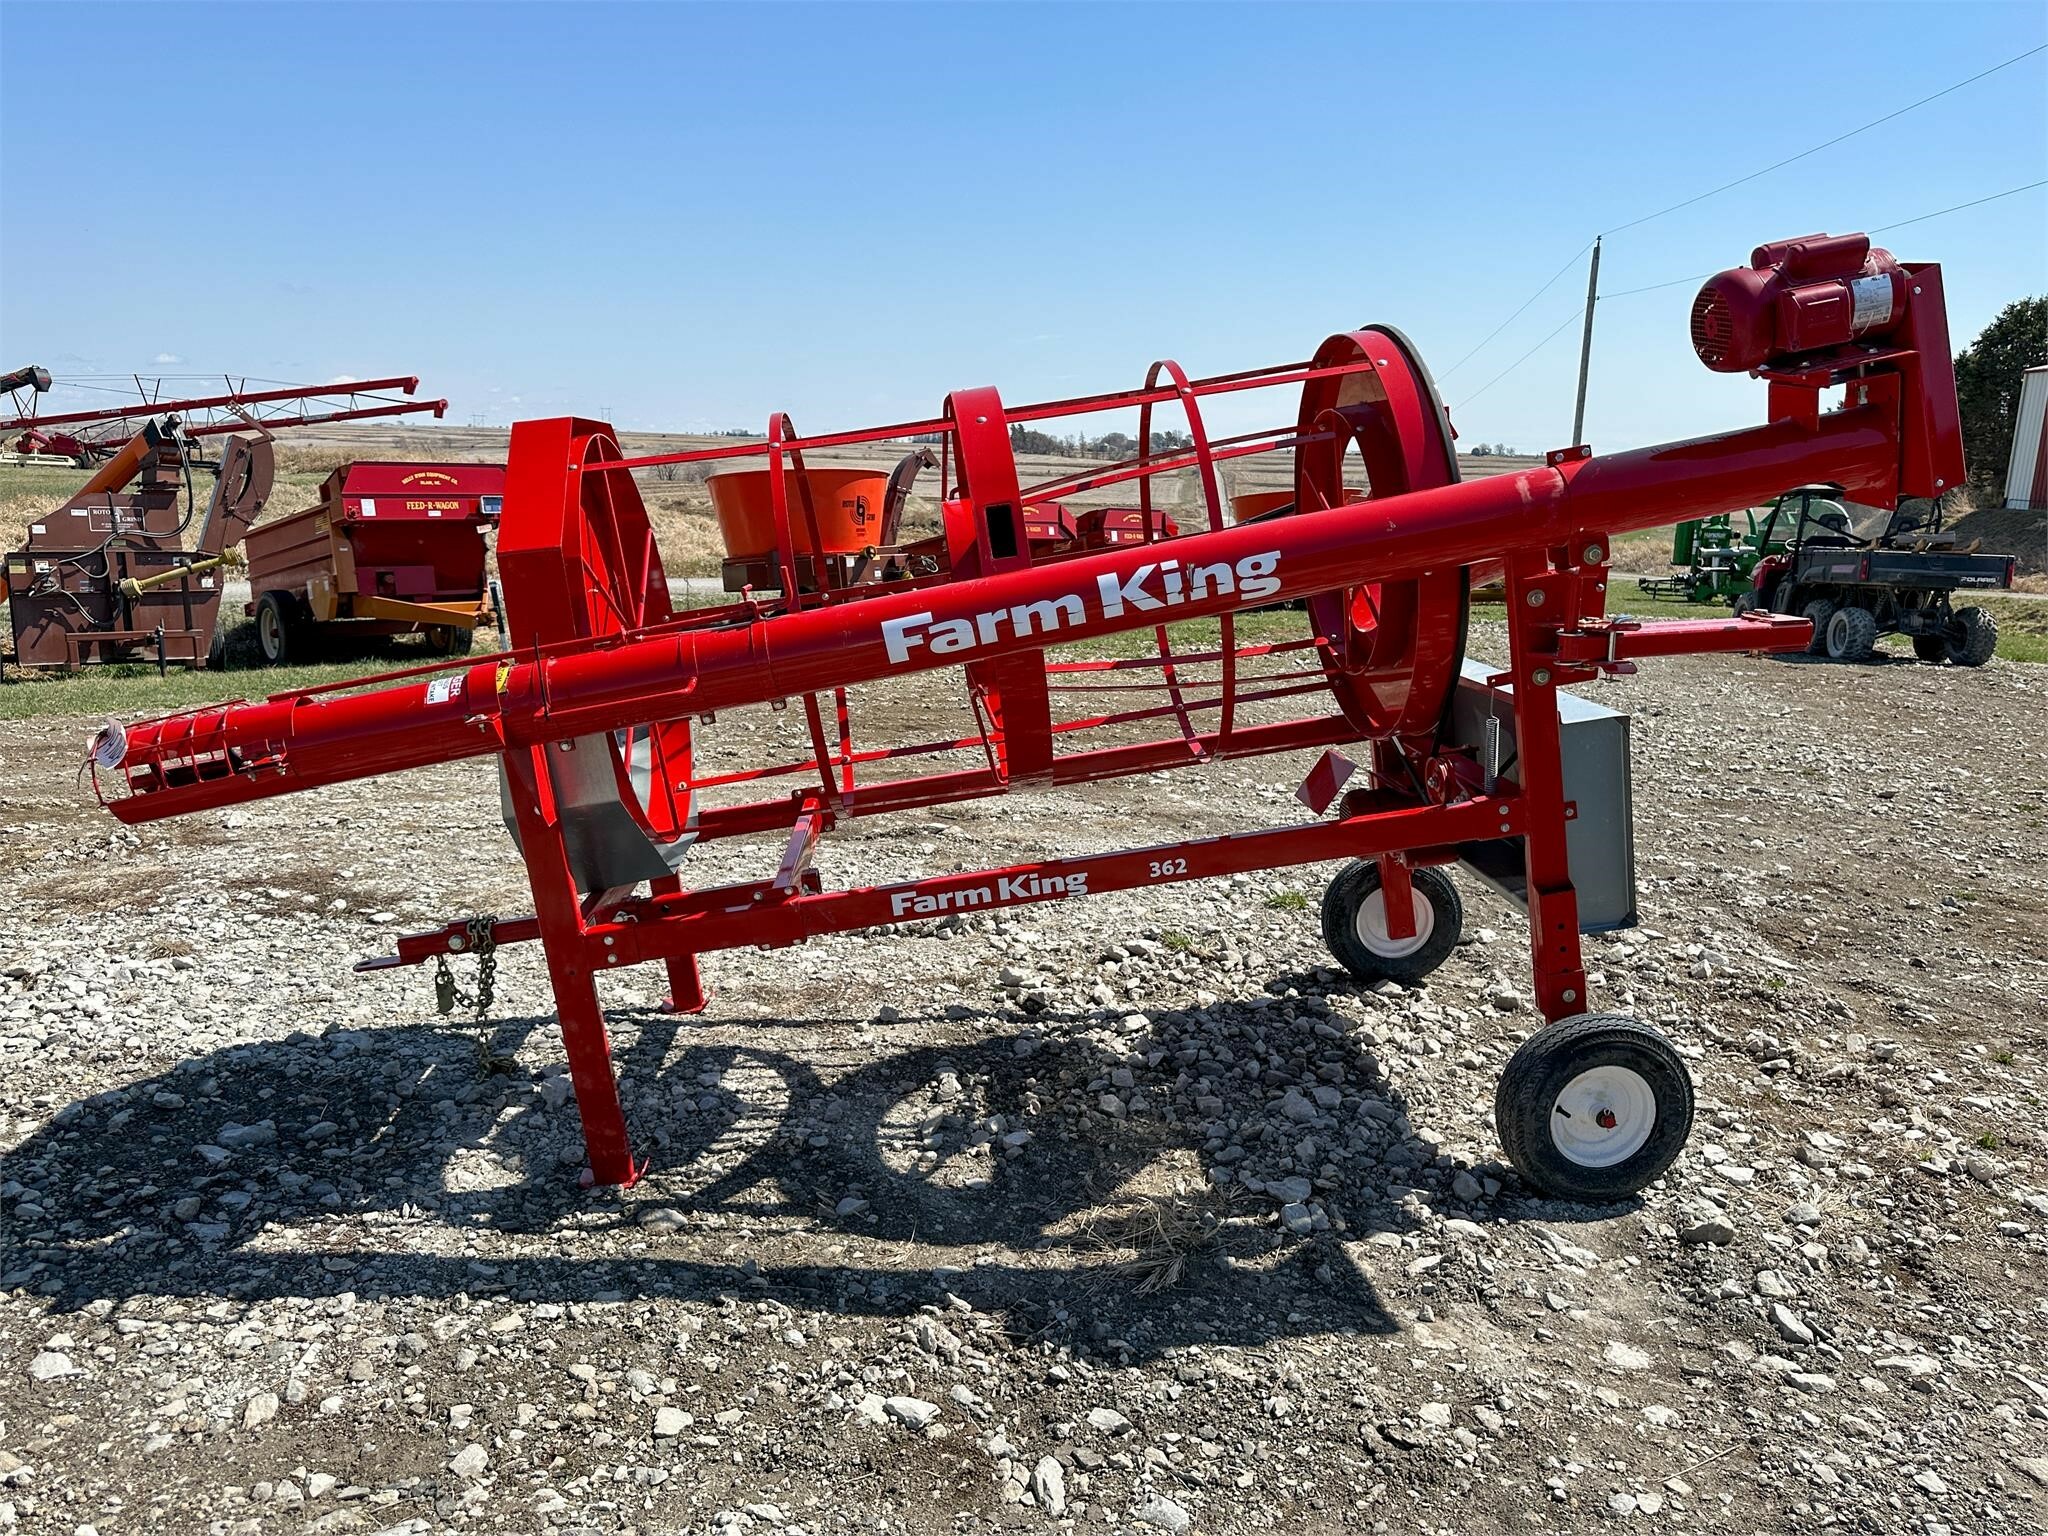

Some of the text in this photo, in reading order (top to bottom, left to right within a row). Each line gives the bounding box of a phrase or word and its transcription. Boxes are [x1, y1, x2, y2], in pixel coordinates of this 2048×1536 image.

[406, 501, 459, 510] FEED-R-WAGON
[881, 550, 1282, 665] Farm King
[890, 858, 1188, 917] Farm King 362
